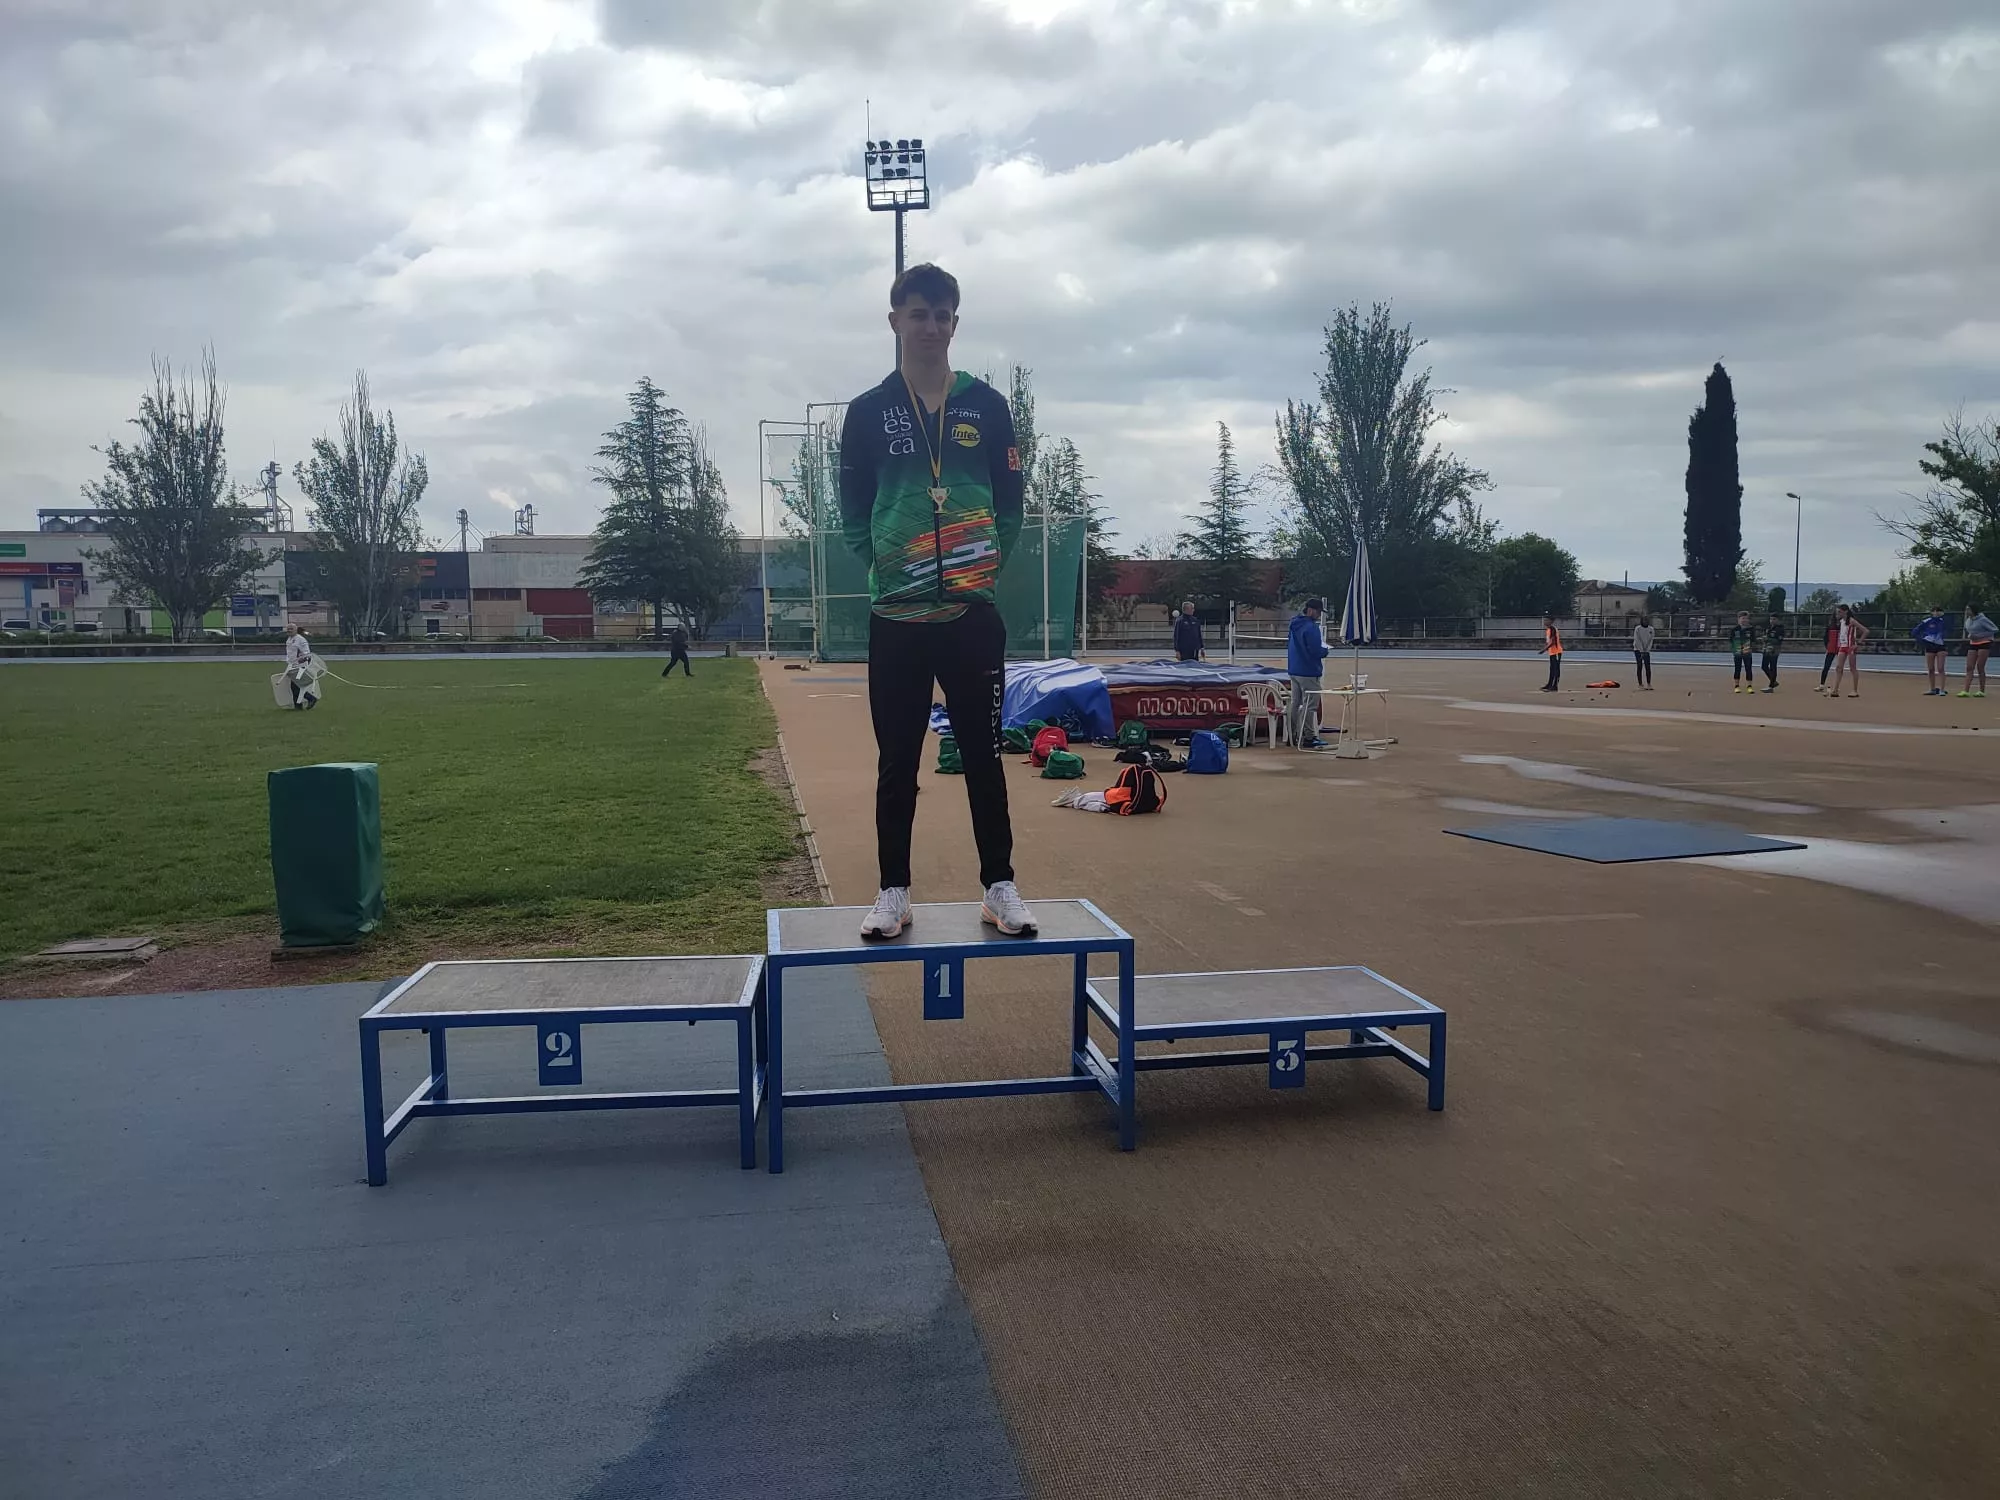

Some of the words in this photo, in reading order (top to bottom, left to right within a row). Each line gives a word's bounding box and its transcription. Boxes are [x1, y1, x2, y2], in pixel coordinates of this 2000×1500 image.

[1137, 696, 1231, 717] MONDO
[933, 963, 952, 998] 1
[545, 1031, 573, 1067] 2
[1275, 1039, 1300, 1072] 3
